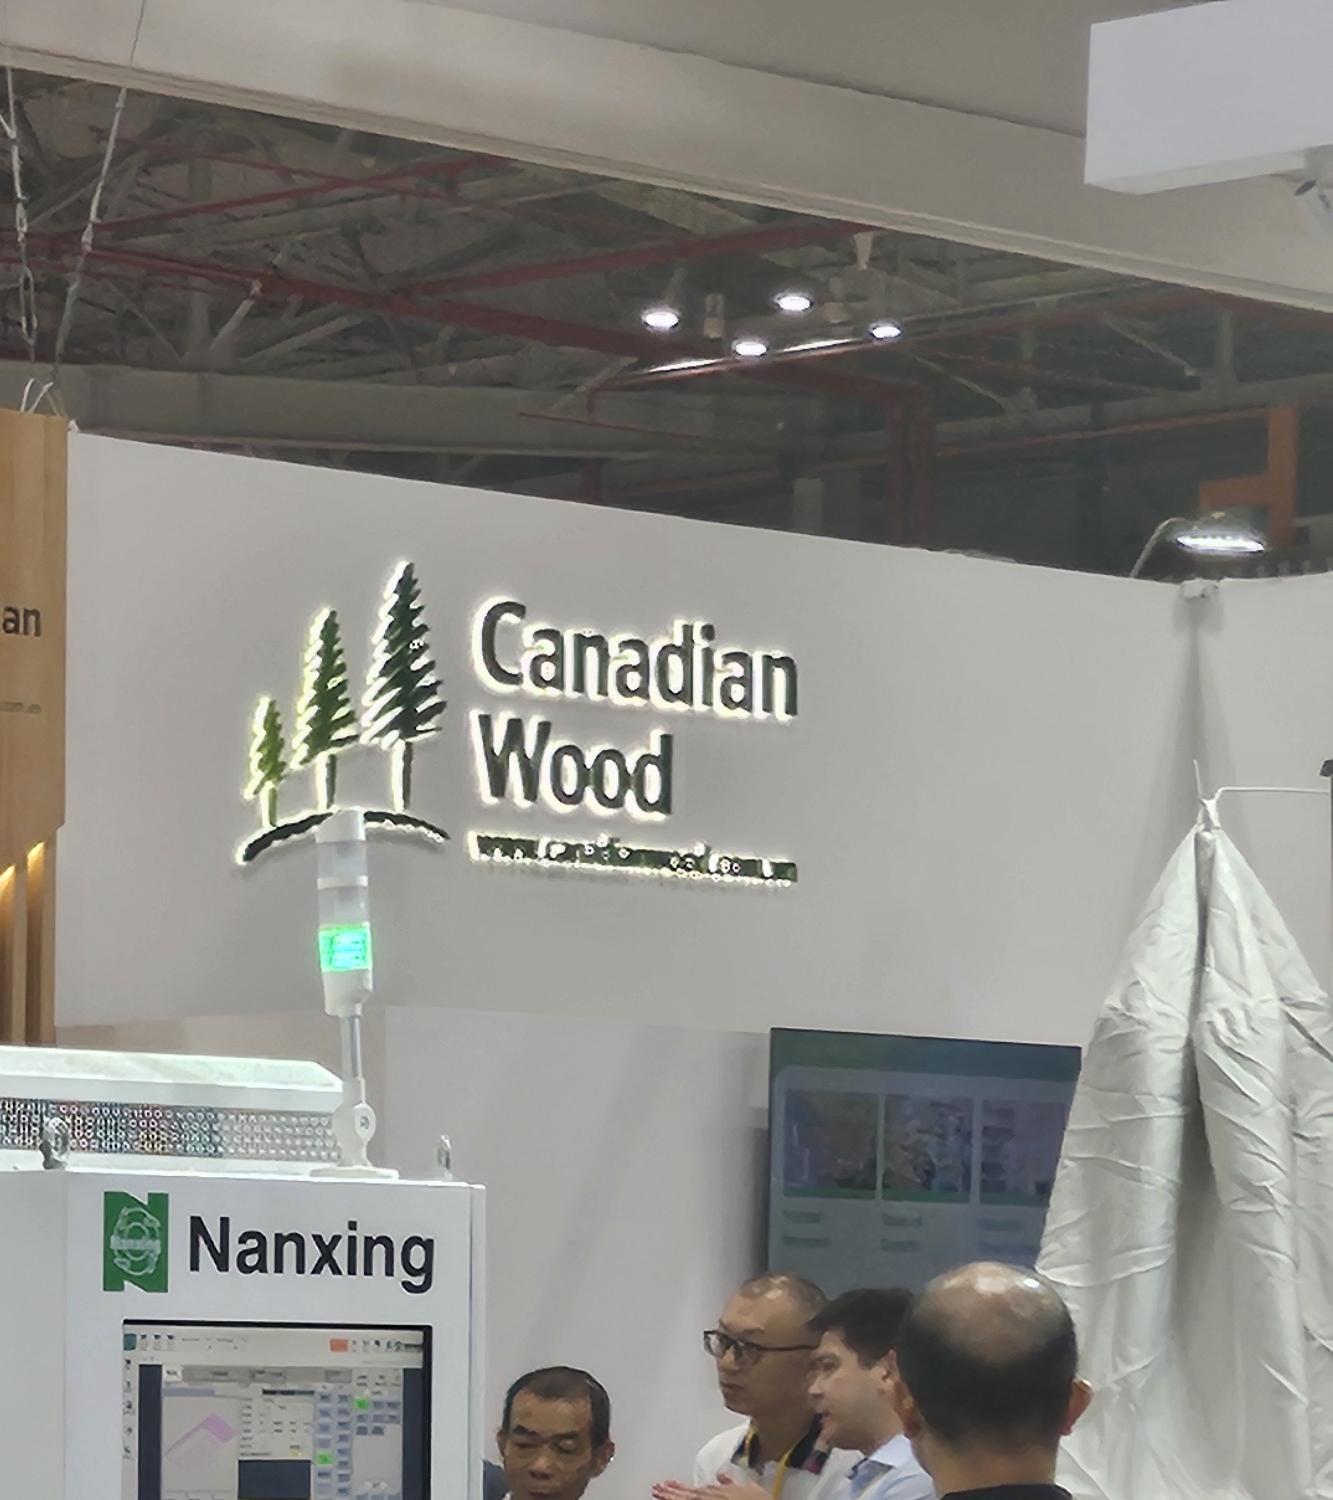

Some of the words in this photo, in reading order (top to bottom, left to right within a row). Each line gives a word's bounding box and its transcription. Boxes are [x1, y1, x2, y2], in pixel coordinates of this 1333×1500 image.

[477, 599, 798, 719] Canadian
[475, 712, 674, 819] Wood
[189, 1215, 435, 1294] Nanxing
